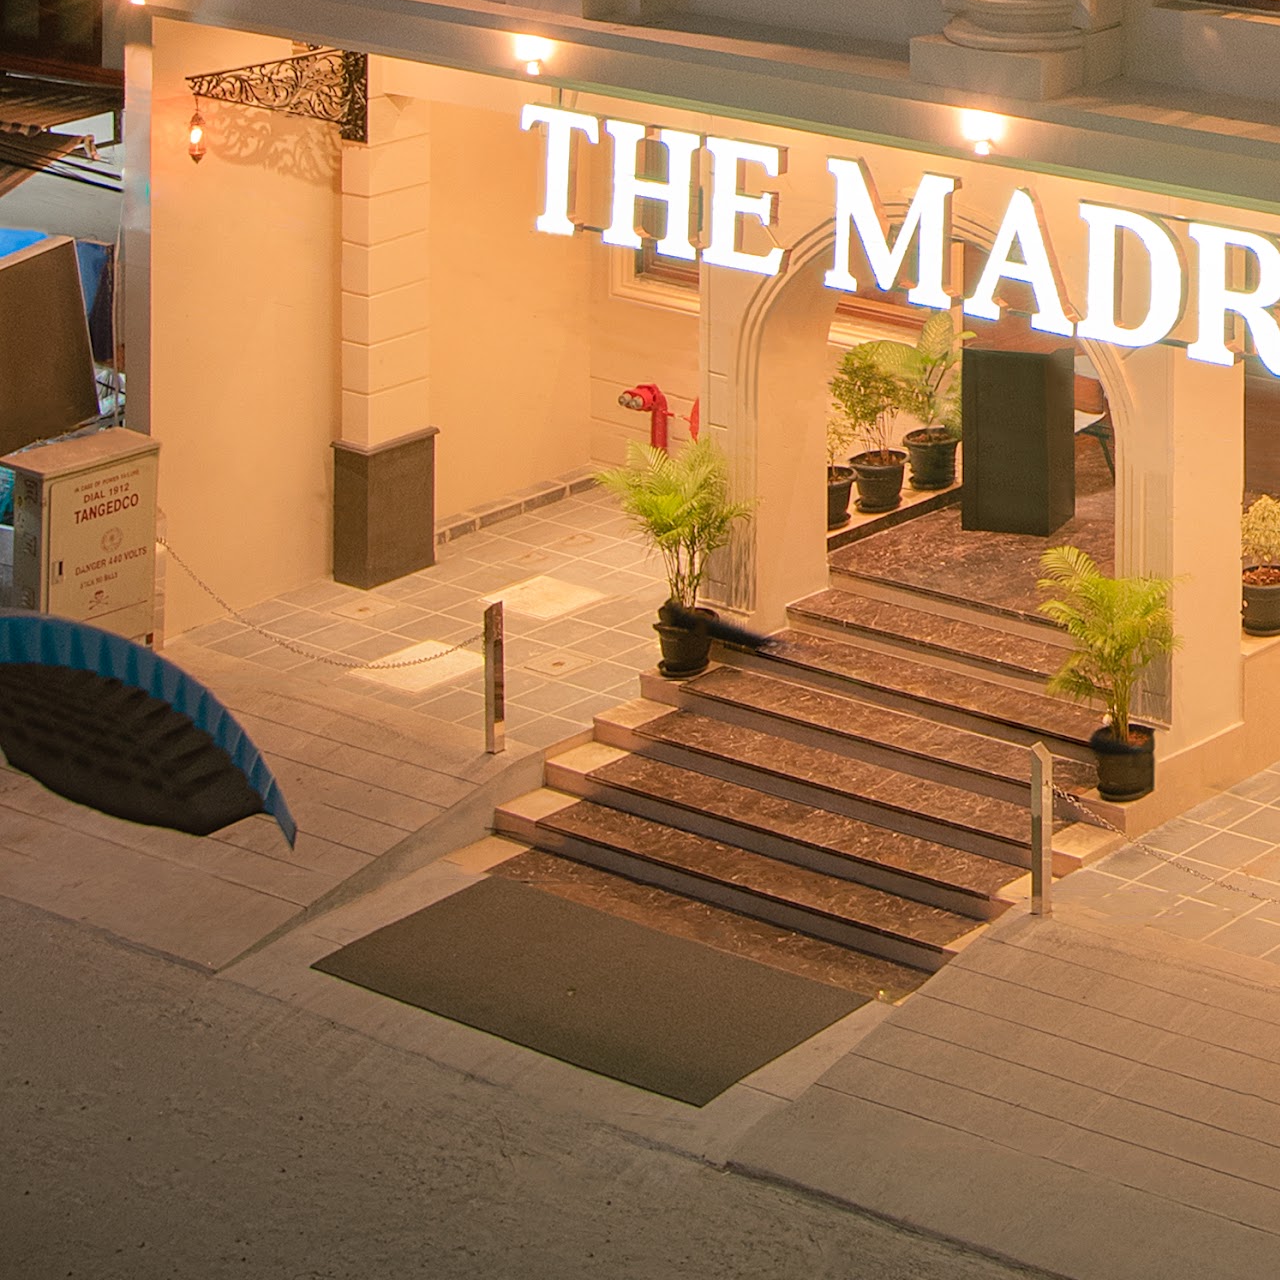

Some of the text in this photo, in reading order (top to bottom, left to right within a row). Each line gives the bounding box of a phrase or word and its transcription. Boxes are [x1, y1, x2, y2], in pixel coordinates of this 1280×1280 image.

[520, 102, 788, 277] THE
[83, 482, 130, 504] DIAL 1912
[74, 493, 139, 525] TANGEDCO
[75, 558, 107, 576] DANGER
[123, 545, 147, 560] VOLTS
